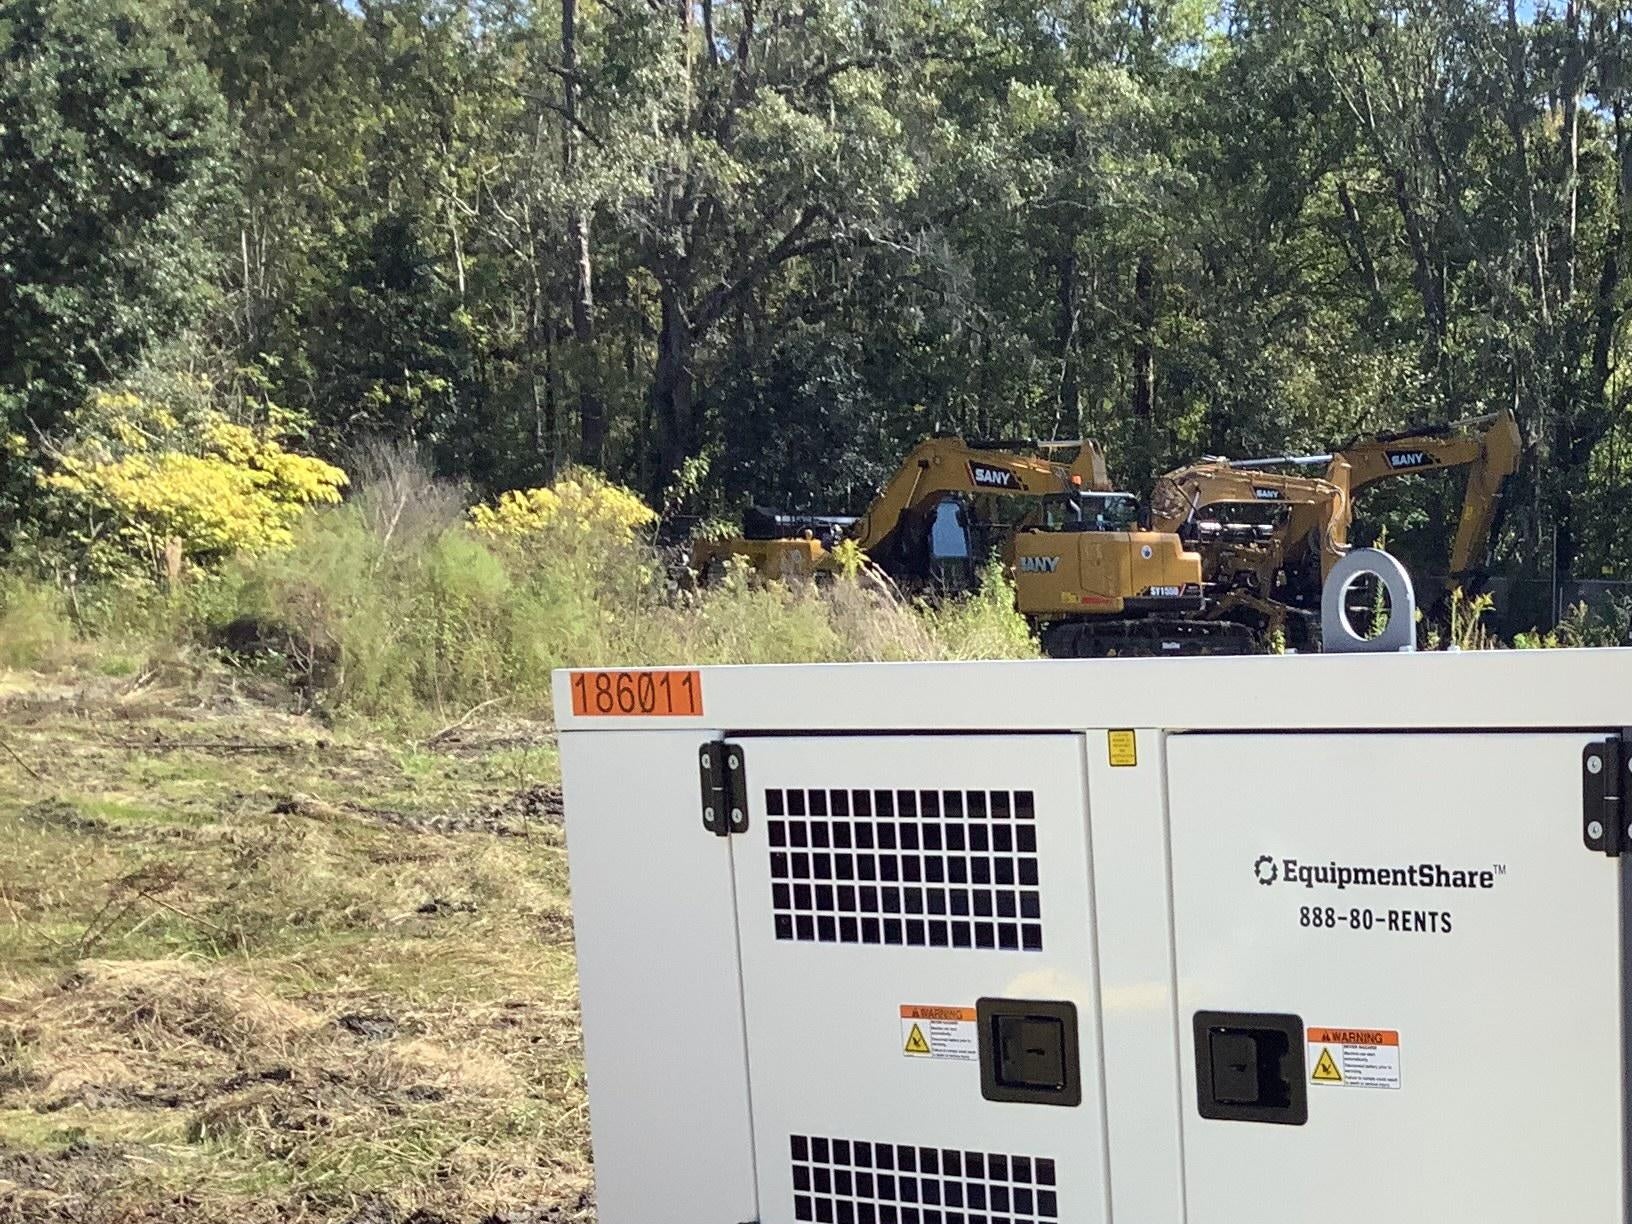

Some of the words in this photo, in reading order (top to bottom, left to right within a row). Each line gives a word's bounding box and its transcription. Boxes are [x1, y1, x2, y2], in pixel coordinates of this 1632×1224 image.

[1391, 453, 1423, 466] SANY
[974, 468, 1010, 485] SANY
[1019, 556, 1060, 573] SANY
[575, 672, 695, 713] 186011
[1300, 905, 1453, 934] 888-80-RENTS
[1332, 1031, 1383, 1044] WARNING
